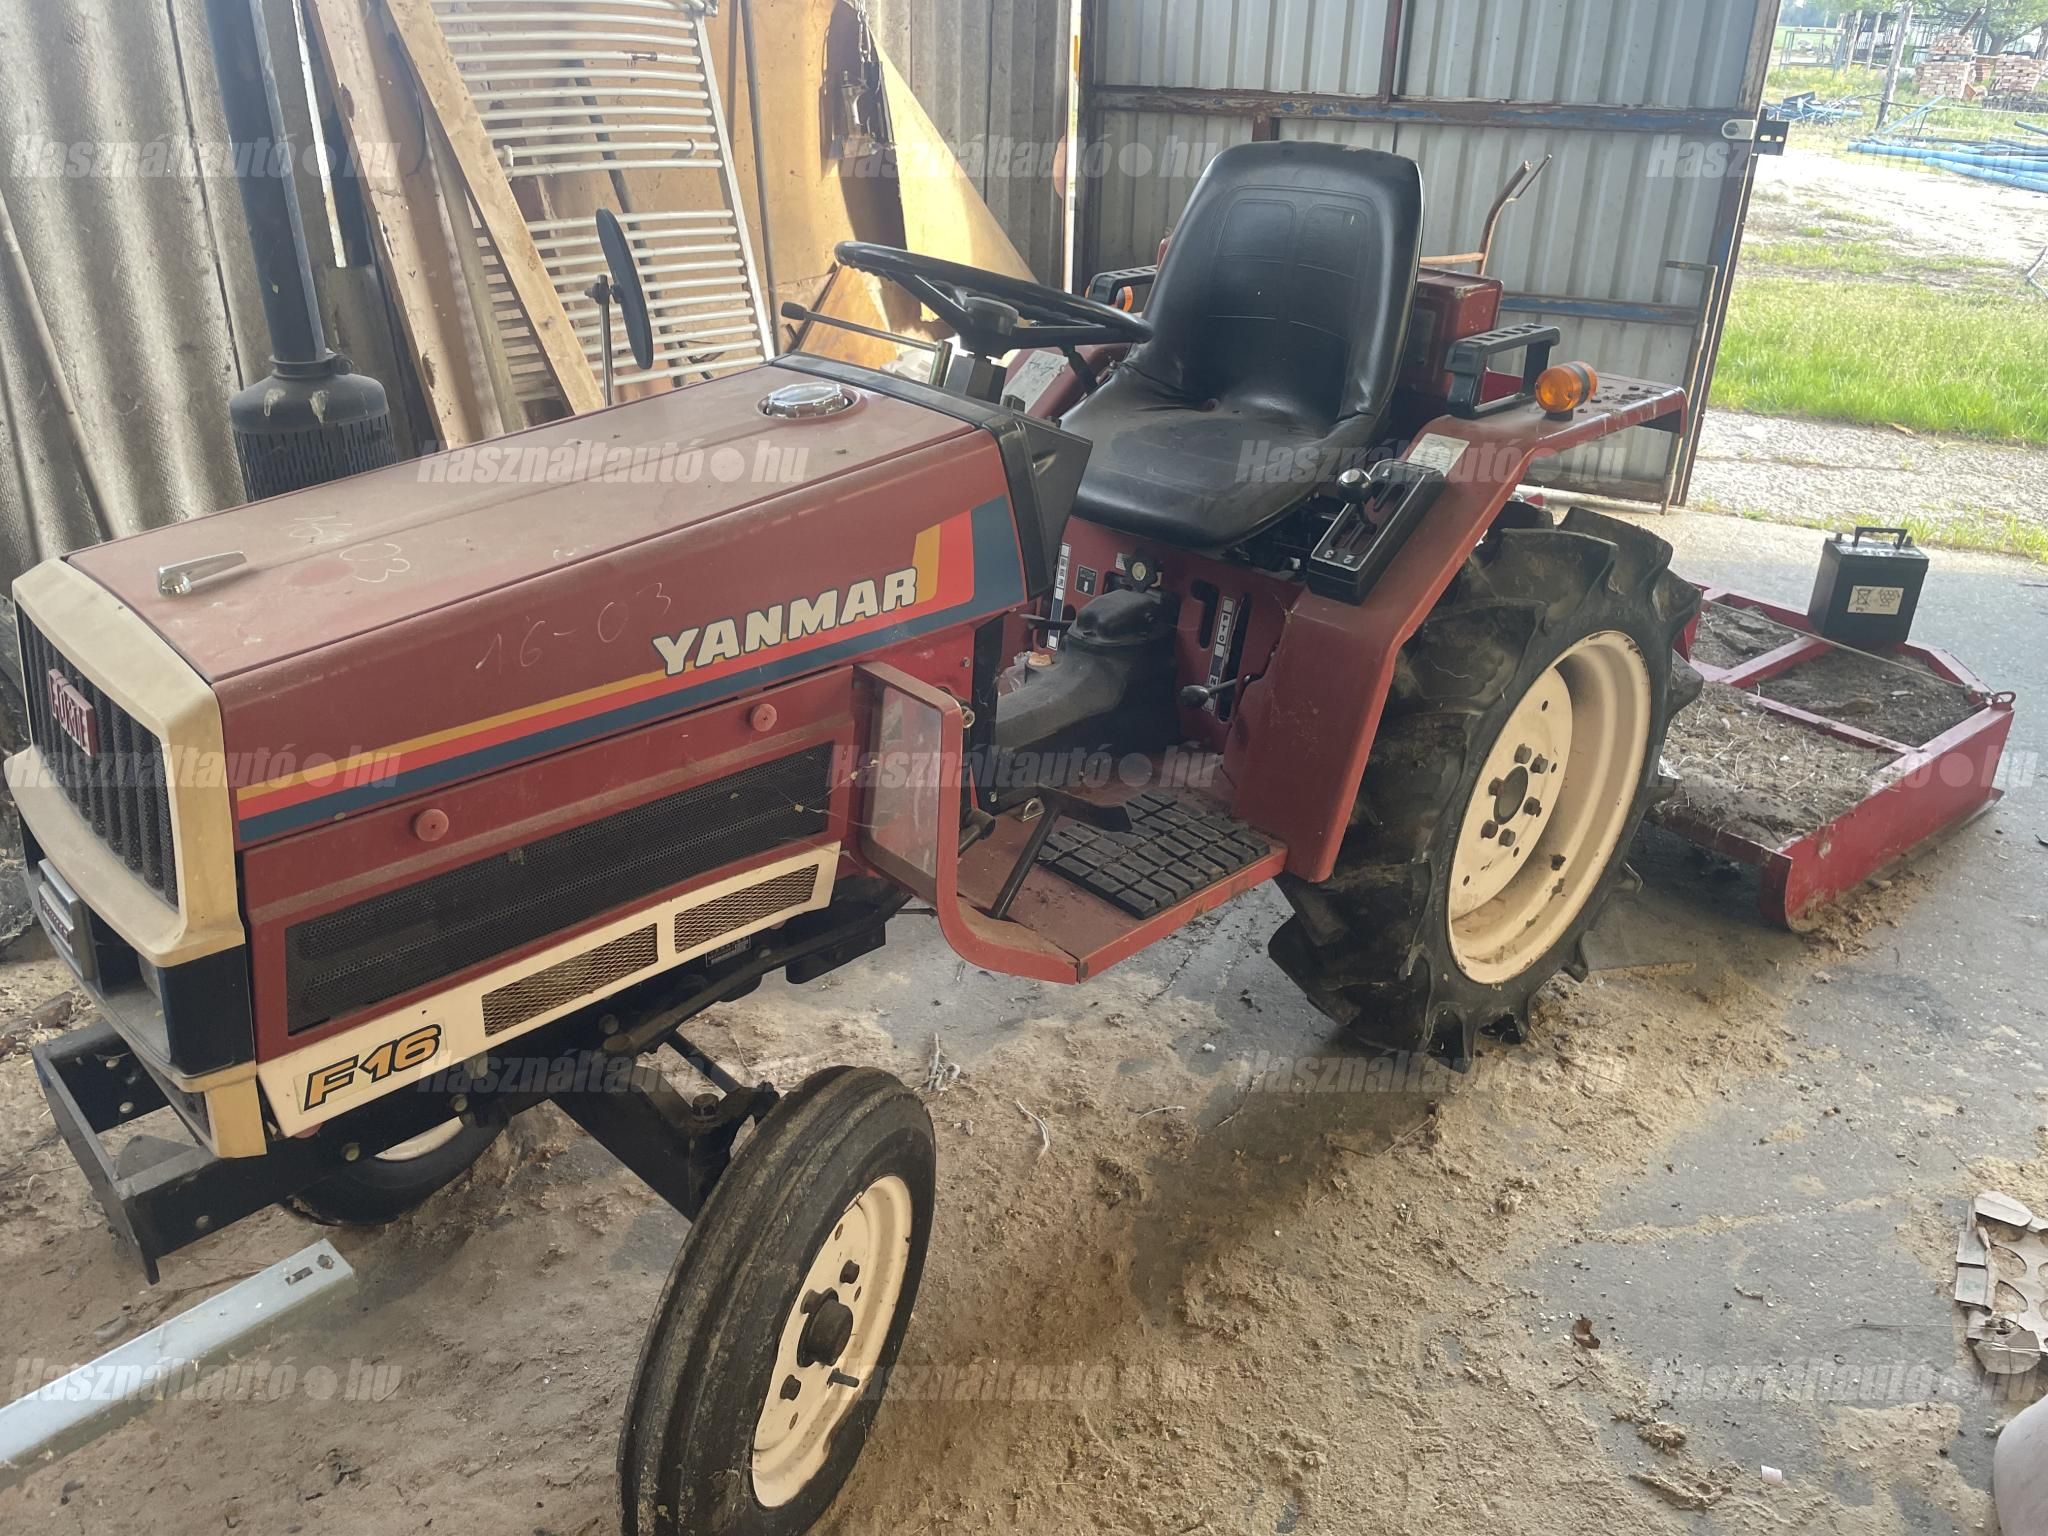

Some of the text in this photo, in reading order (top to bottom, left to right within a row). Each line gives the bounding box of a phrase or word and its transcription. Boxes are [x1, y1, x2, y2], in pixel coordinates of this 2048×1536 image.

[652, 566, 918, 677] YANMAR
[1218, 613, 1230, 643] PTO
[303, 1023, 442, 1112] F16
